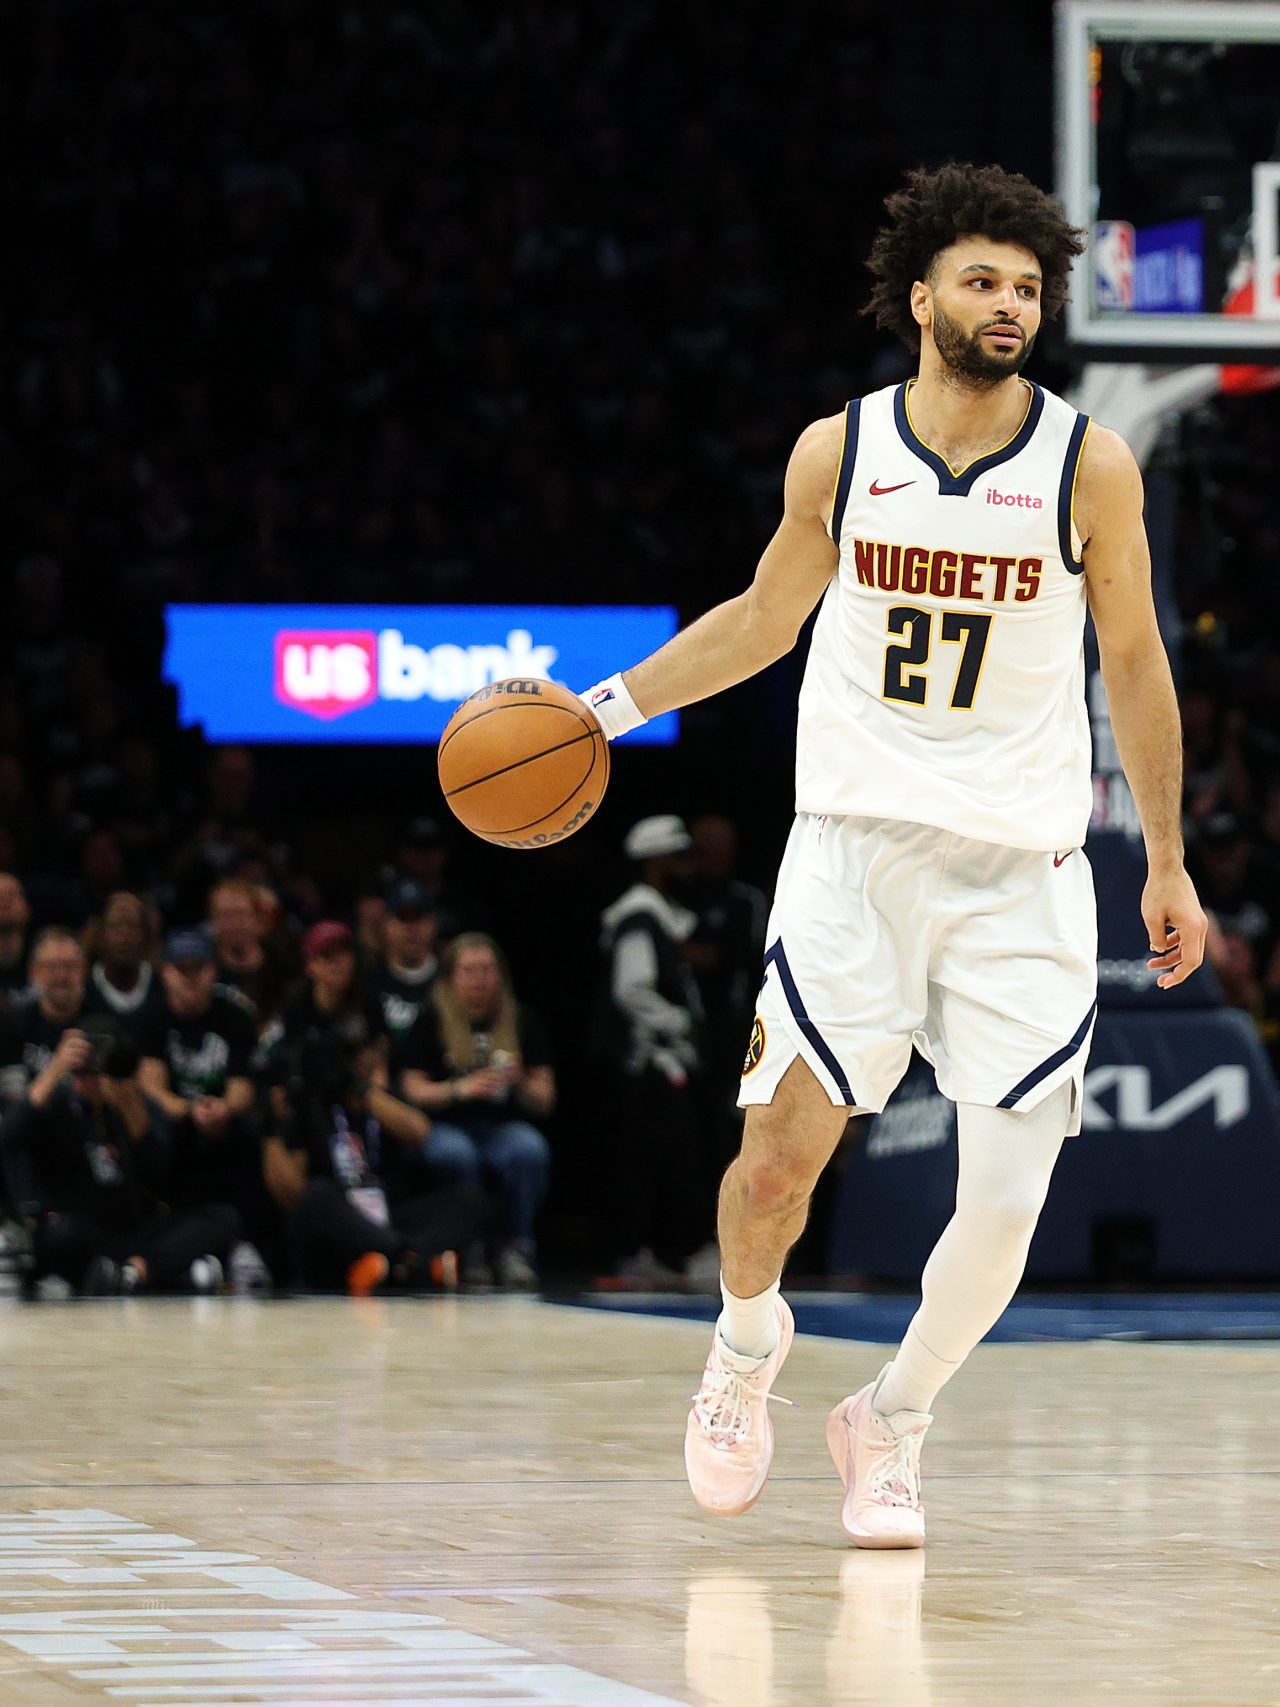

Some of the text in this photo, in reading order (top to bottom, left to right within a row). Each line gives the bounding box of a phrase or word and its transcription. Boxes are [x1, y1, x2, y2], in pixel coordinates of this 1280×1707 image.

[986, 488, 1043, 510] ibotta
[853, 537, 1043, 603] NUGGETS
[283, 628, 560, 700] us bank
[881, 603, 995, 712] 27
